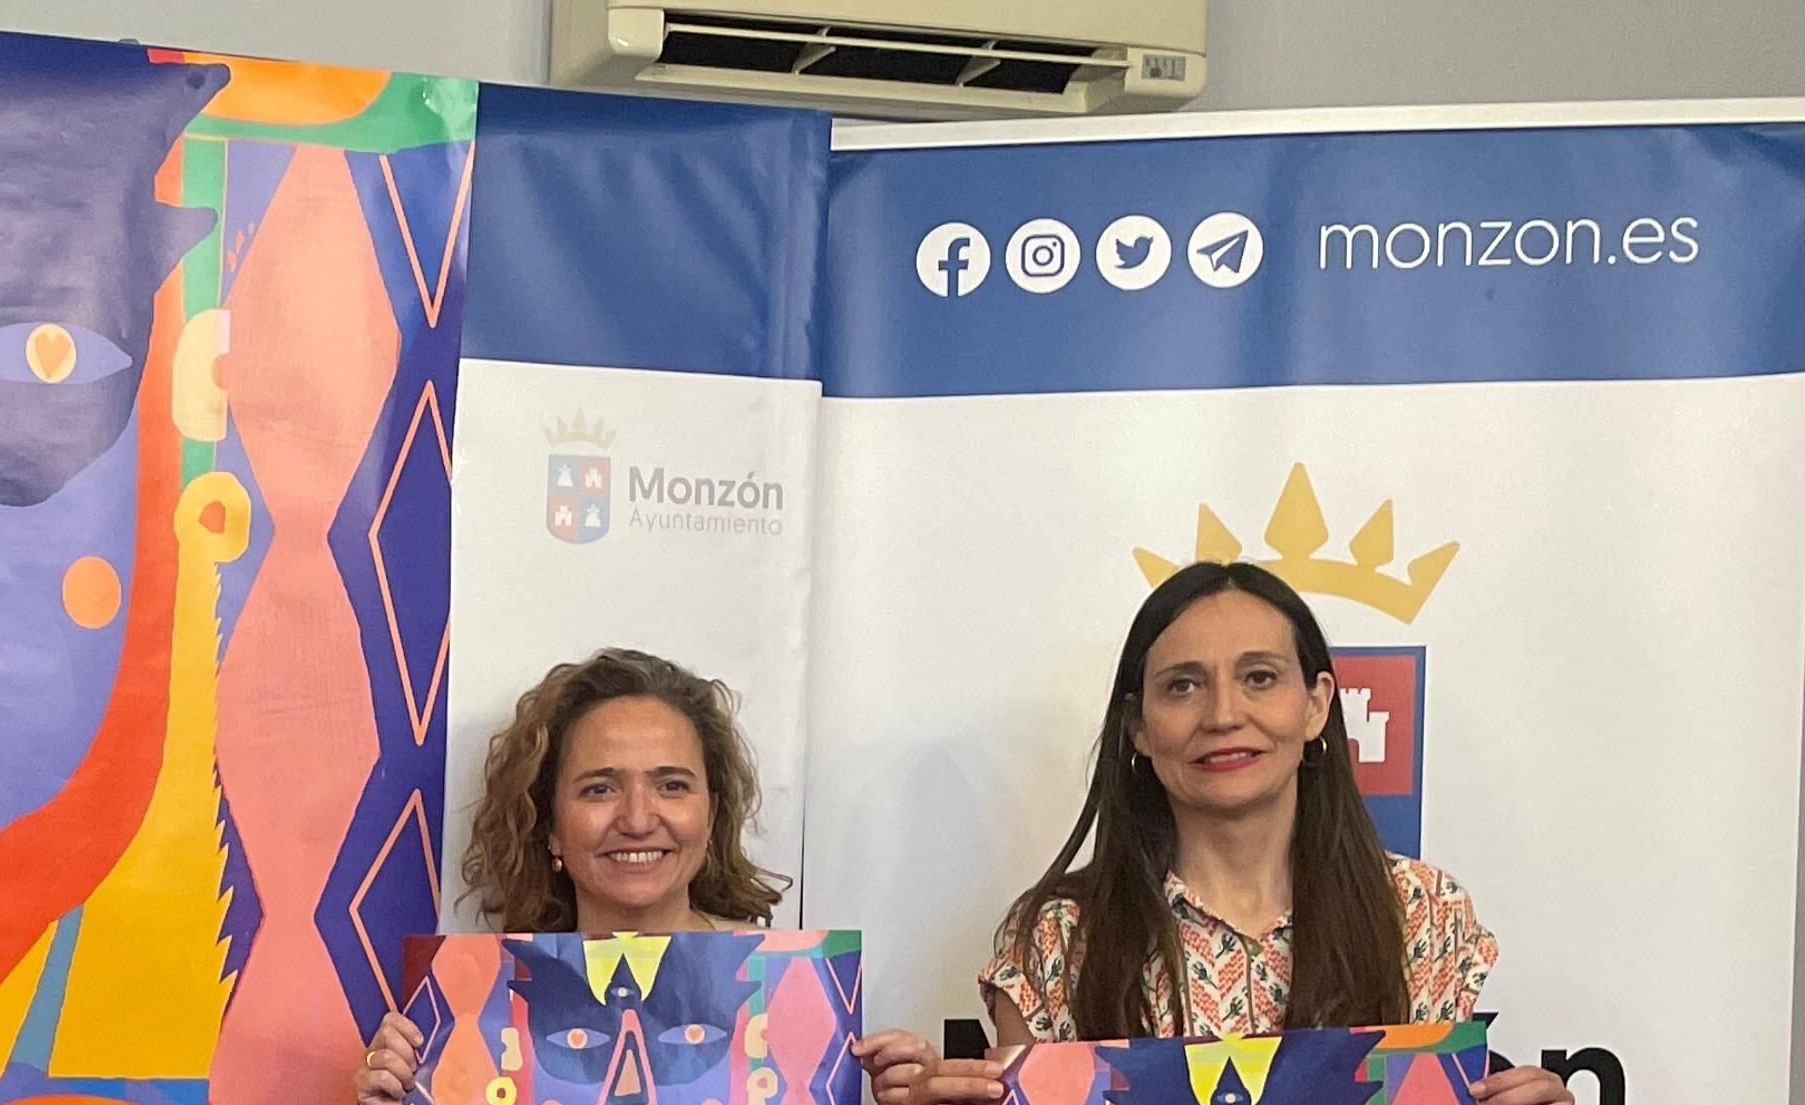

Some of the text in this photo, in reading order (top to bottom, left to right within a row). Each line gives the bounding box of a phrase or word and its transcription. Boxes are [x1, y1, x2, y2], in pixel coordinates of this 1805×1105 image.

[1320, 218, 1698, 268] monzon.es
[630, 467, 783, 510] Monzón
[629, 506, 784, 538] Ayuntamiento
